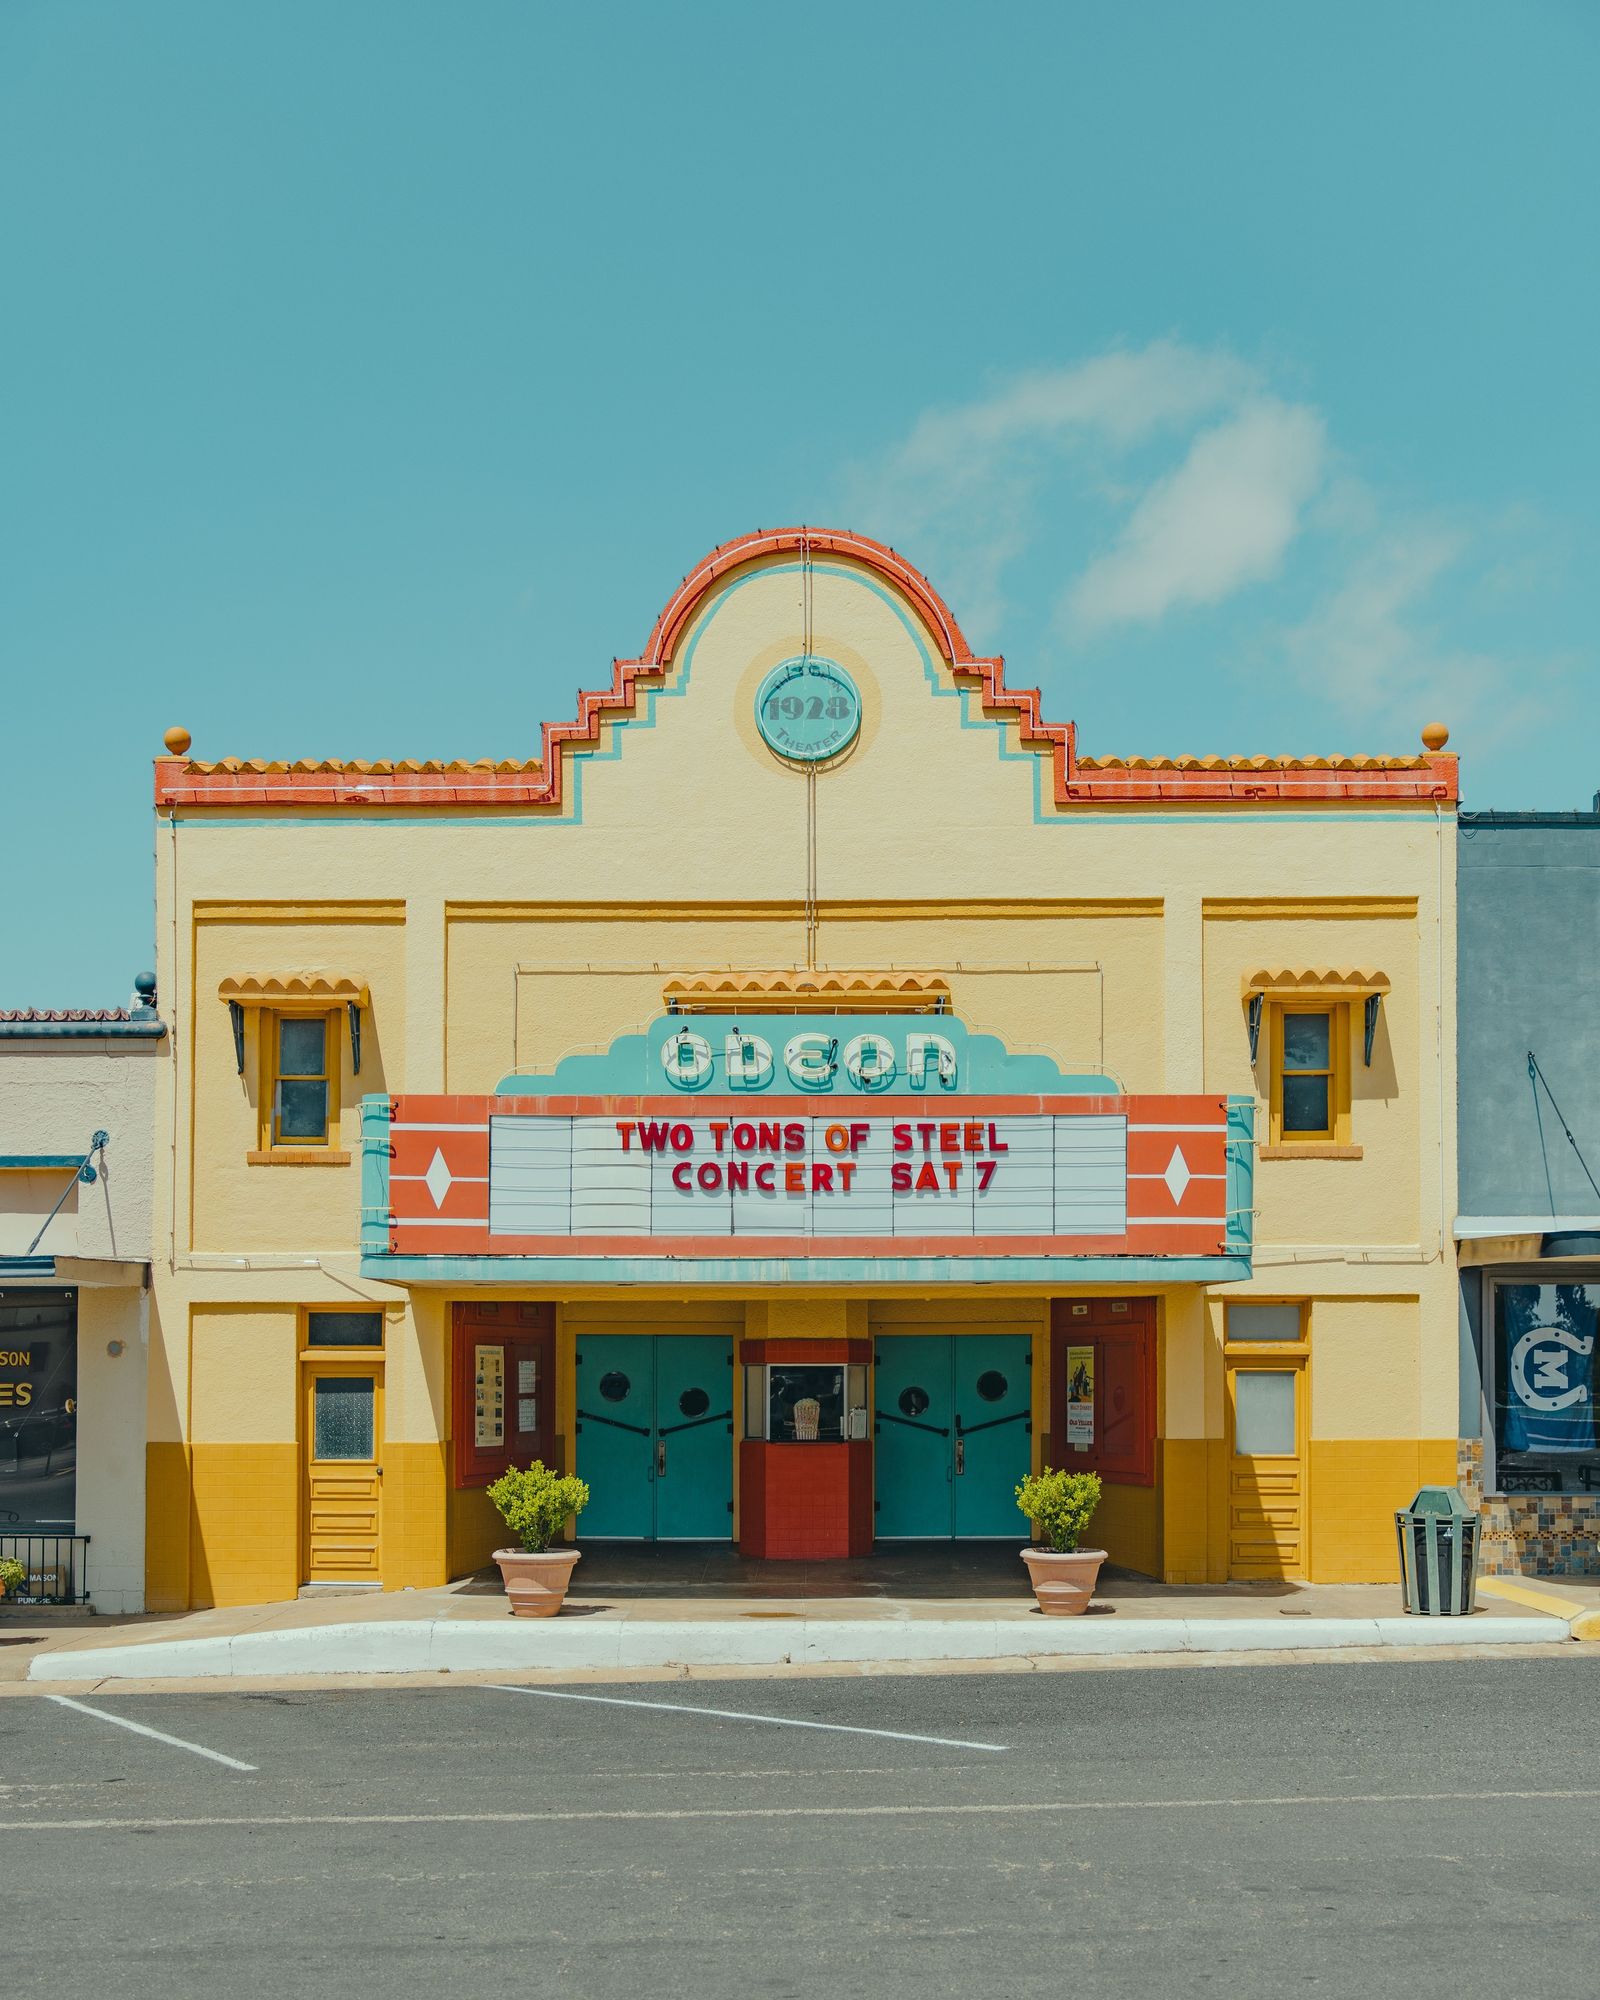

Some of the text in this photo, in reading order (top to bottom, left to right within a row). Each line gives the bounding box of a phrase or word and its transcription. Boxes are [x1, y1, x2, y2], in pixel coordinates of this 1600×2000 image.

[769, 696, 851, 721] 1928
[776, 727, 842, 753] THEATER
[616, 1121, 1008, 1152] TWO TONS OF STEEL
[671, 1160, 997, 1192] CONCERT SAT 7
